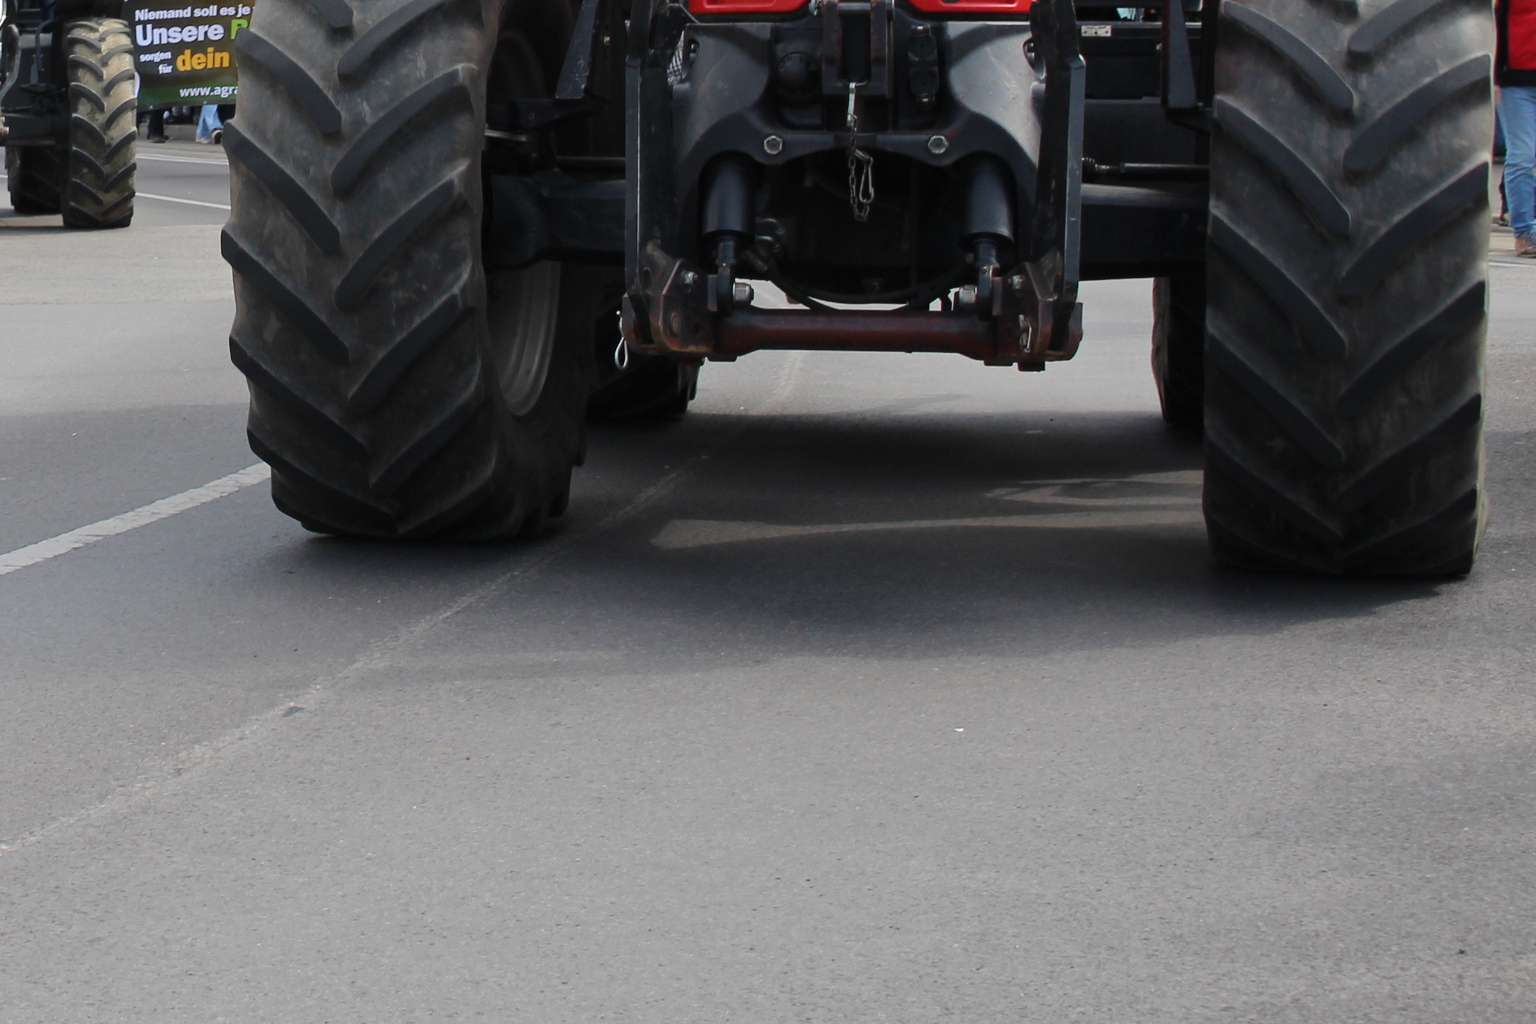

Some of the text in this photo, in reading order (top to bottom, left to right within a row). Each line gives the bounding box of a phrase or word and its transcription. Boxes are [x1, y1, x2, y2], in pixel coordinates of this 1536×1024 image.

[134, 3, 251, 22] Niemand soll es je
[135, 22, 225, 47] Unsere
[139, 47, 231, 72] sorgen dein
[158, 63, 173, 75] für
